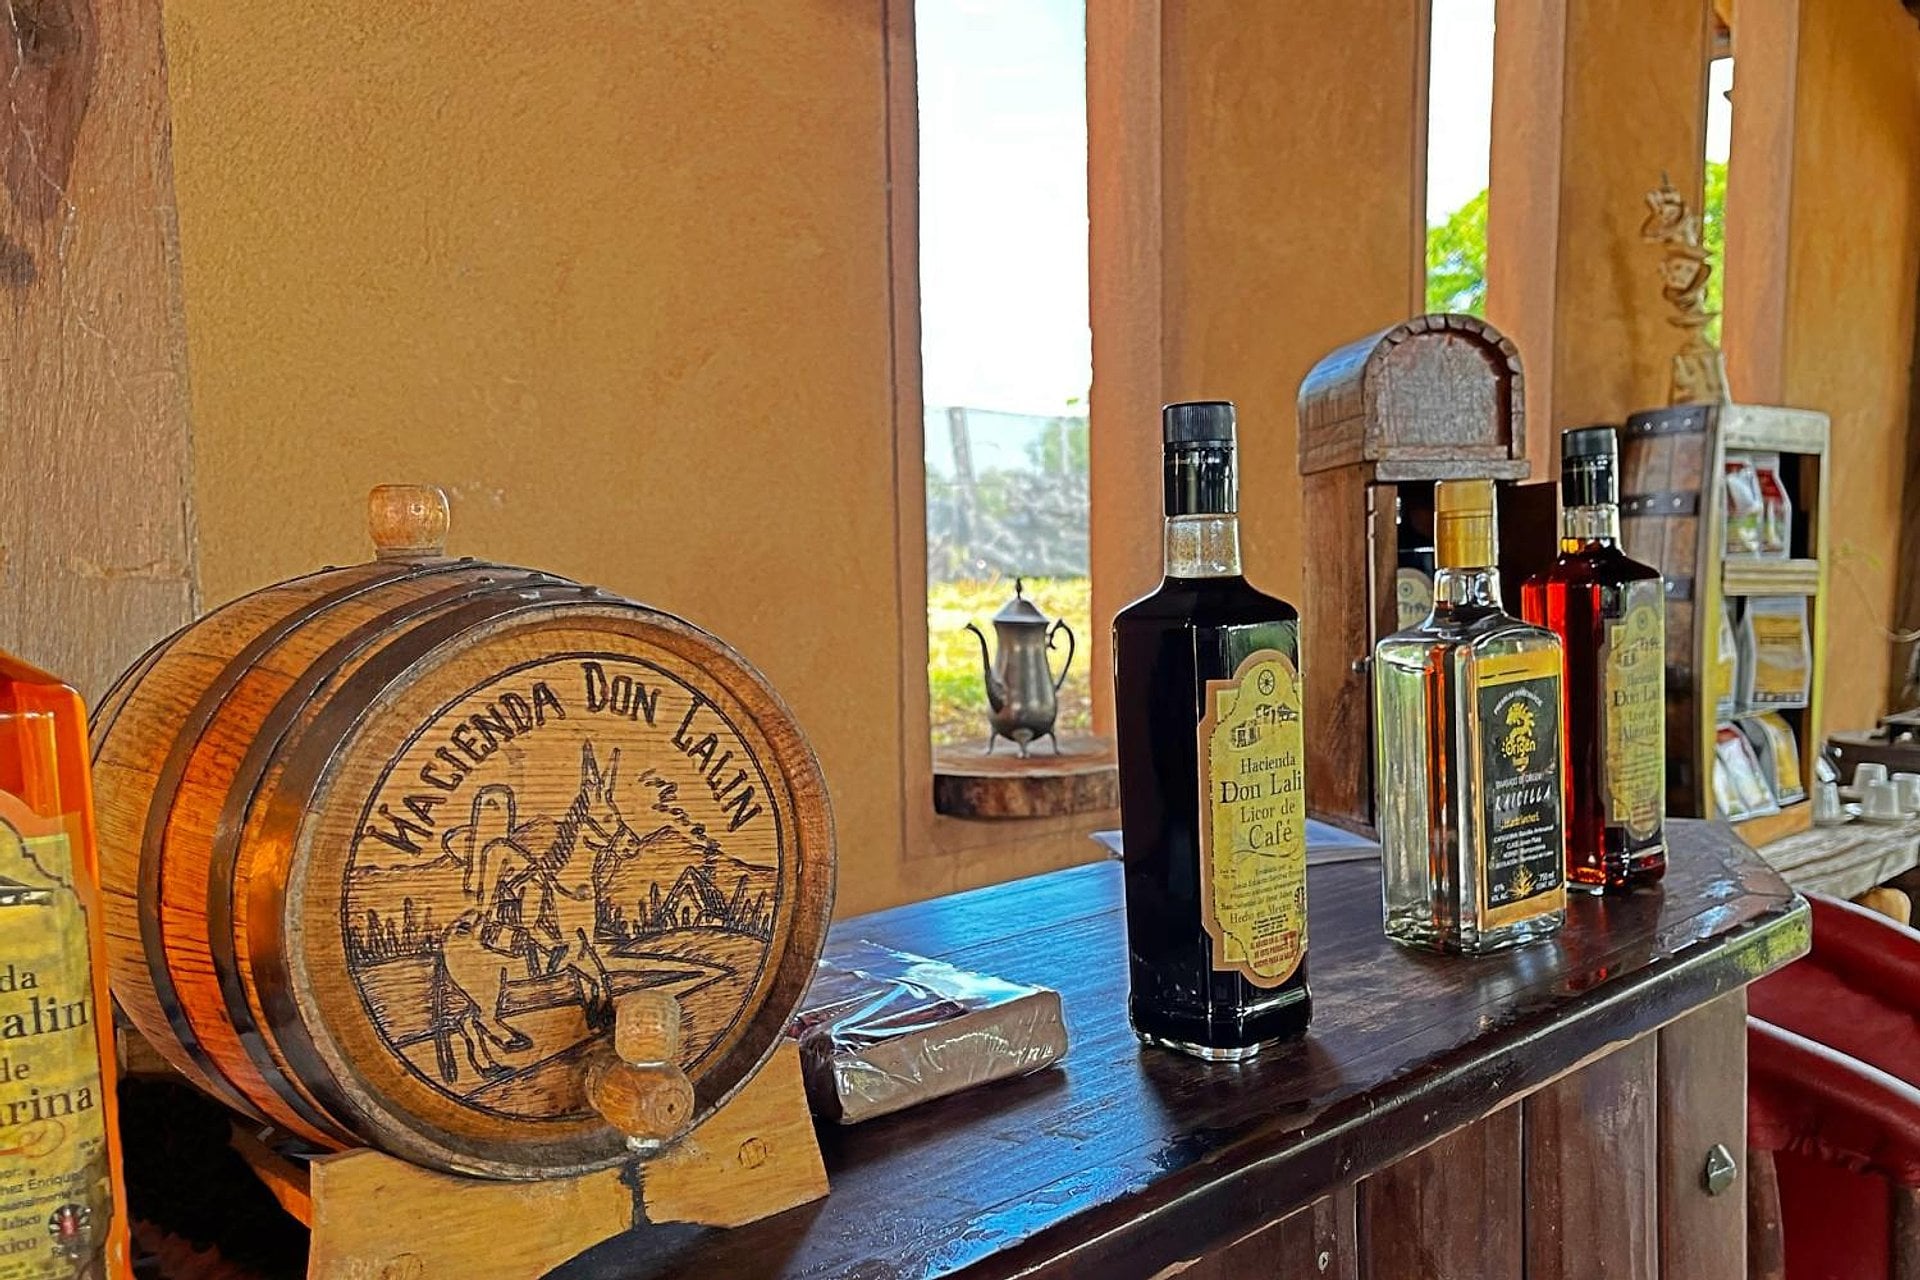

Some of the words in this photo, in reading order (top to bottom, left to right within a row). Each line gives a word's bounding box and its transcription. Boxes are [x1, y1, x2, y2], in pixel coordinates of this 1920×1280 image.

[367, 682, 566, 855] HACIENDA
[581, 661, 661, 727] DON
[671, 695, 763, 832] LALIN
[1241, 751, 1296, 774] Hacienda
[1220, 780, 1261, 804] Don
[1240, 806, 1276, 824] Licor
[1281, 798, 1295, 815] de
[1249, 820, 1292, 849] Café
